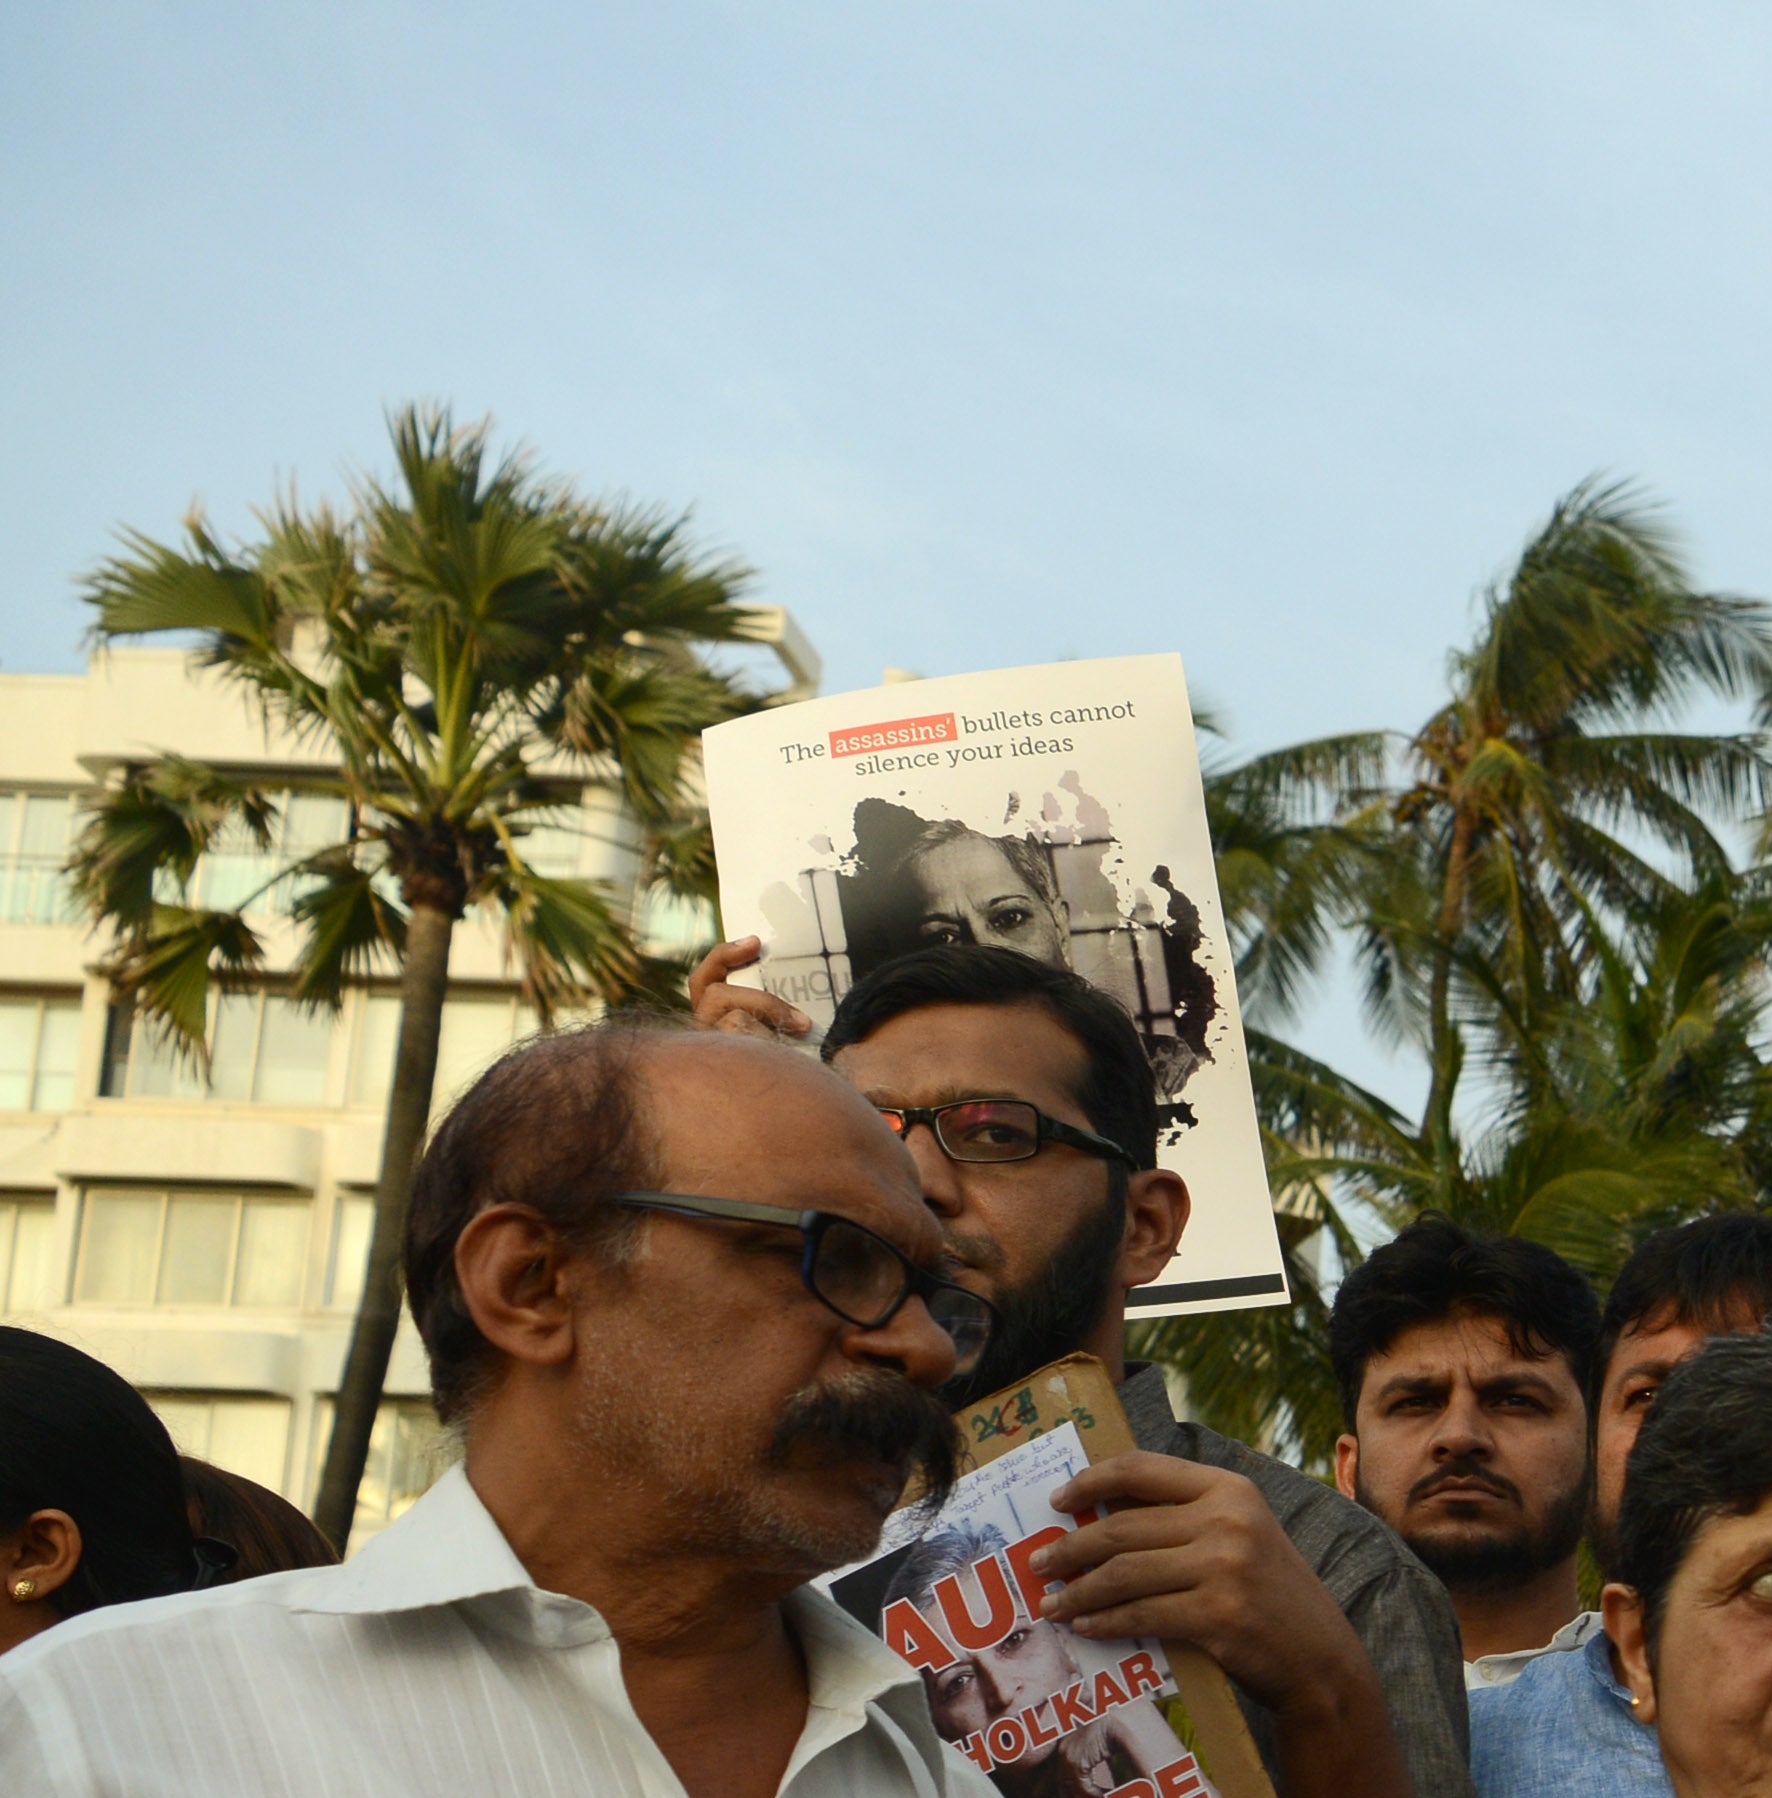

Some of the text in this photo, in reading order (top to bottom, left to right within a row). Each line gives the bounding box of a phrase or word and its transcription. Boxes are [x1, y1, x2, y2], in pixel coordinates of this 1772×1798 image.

[780, 701, 1135, 765] The assassins' bullets cannot
[855, 736, 1073, 776] silence your ideas
[952, 1650, 1165, 1774] HOLKAR
